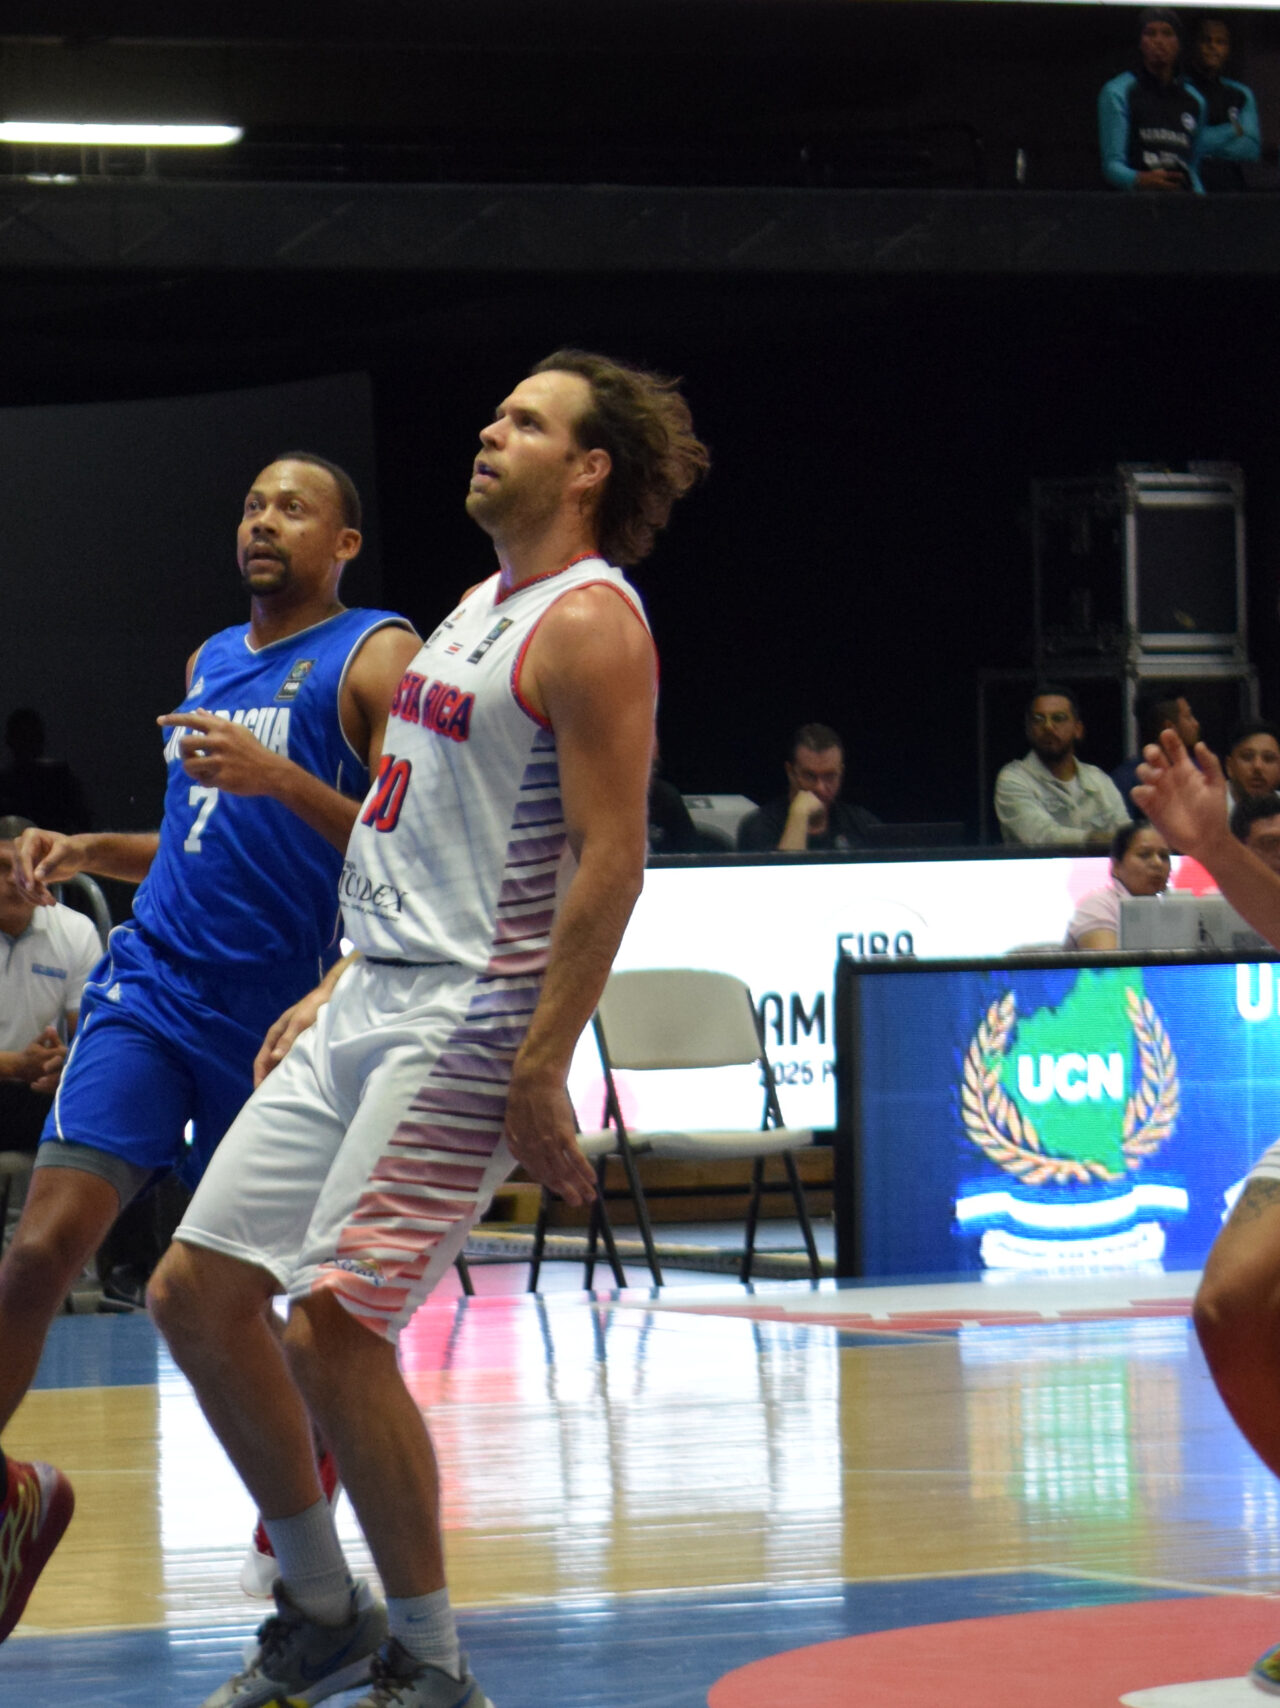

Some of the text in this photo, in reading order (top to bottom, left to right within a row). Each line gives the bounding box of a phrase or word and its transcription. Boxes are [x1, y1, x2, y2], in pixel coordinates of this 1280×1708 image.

[422, 680, 476, 742] RICA
[184, 786, 218, 853] 7
[1017, 1052, 1124, 1103] UCN
